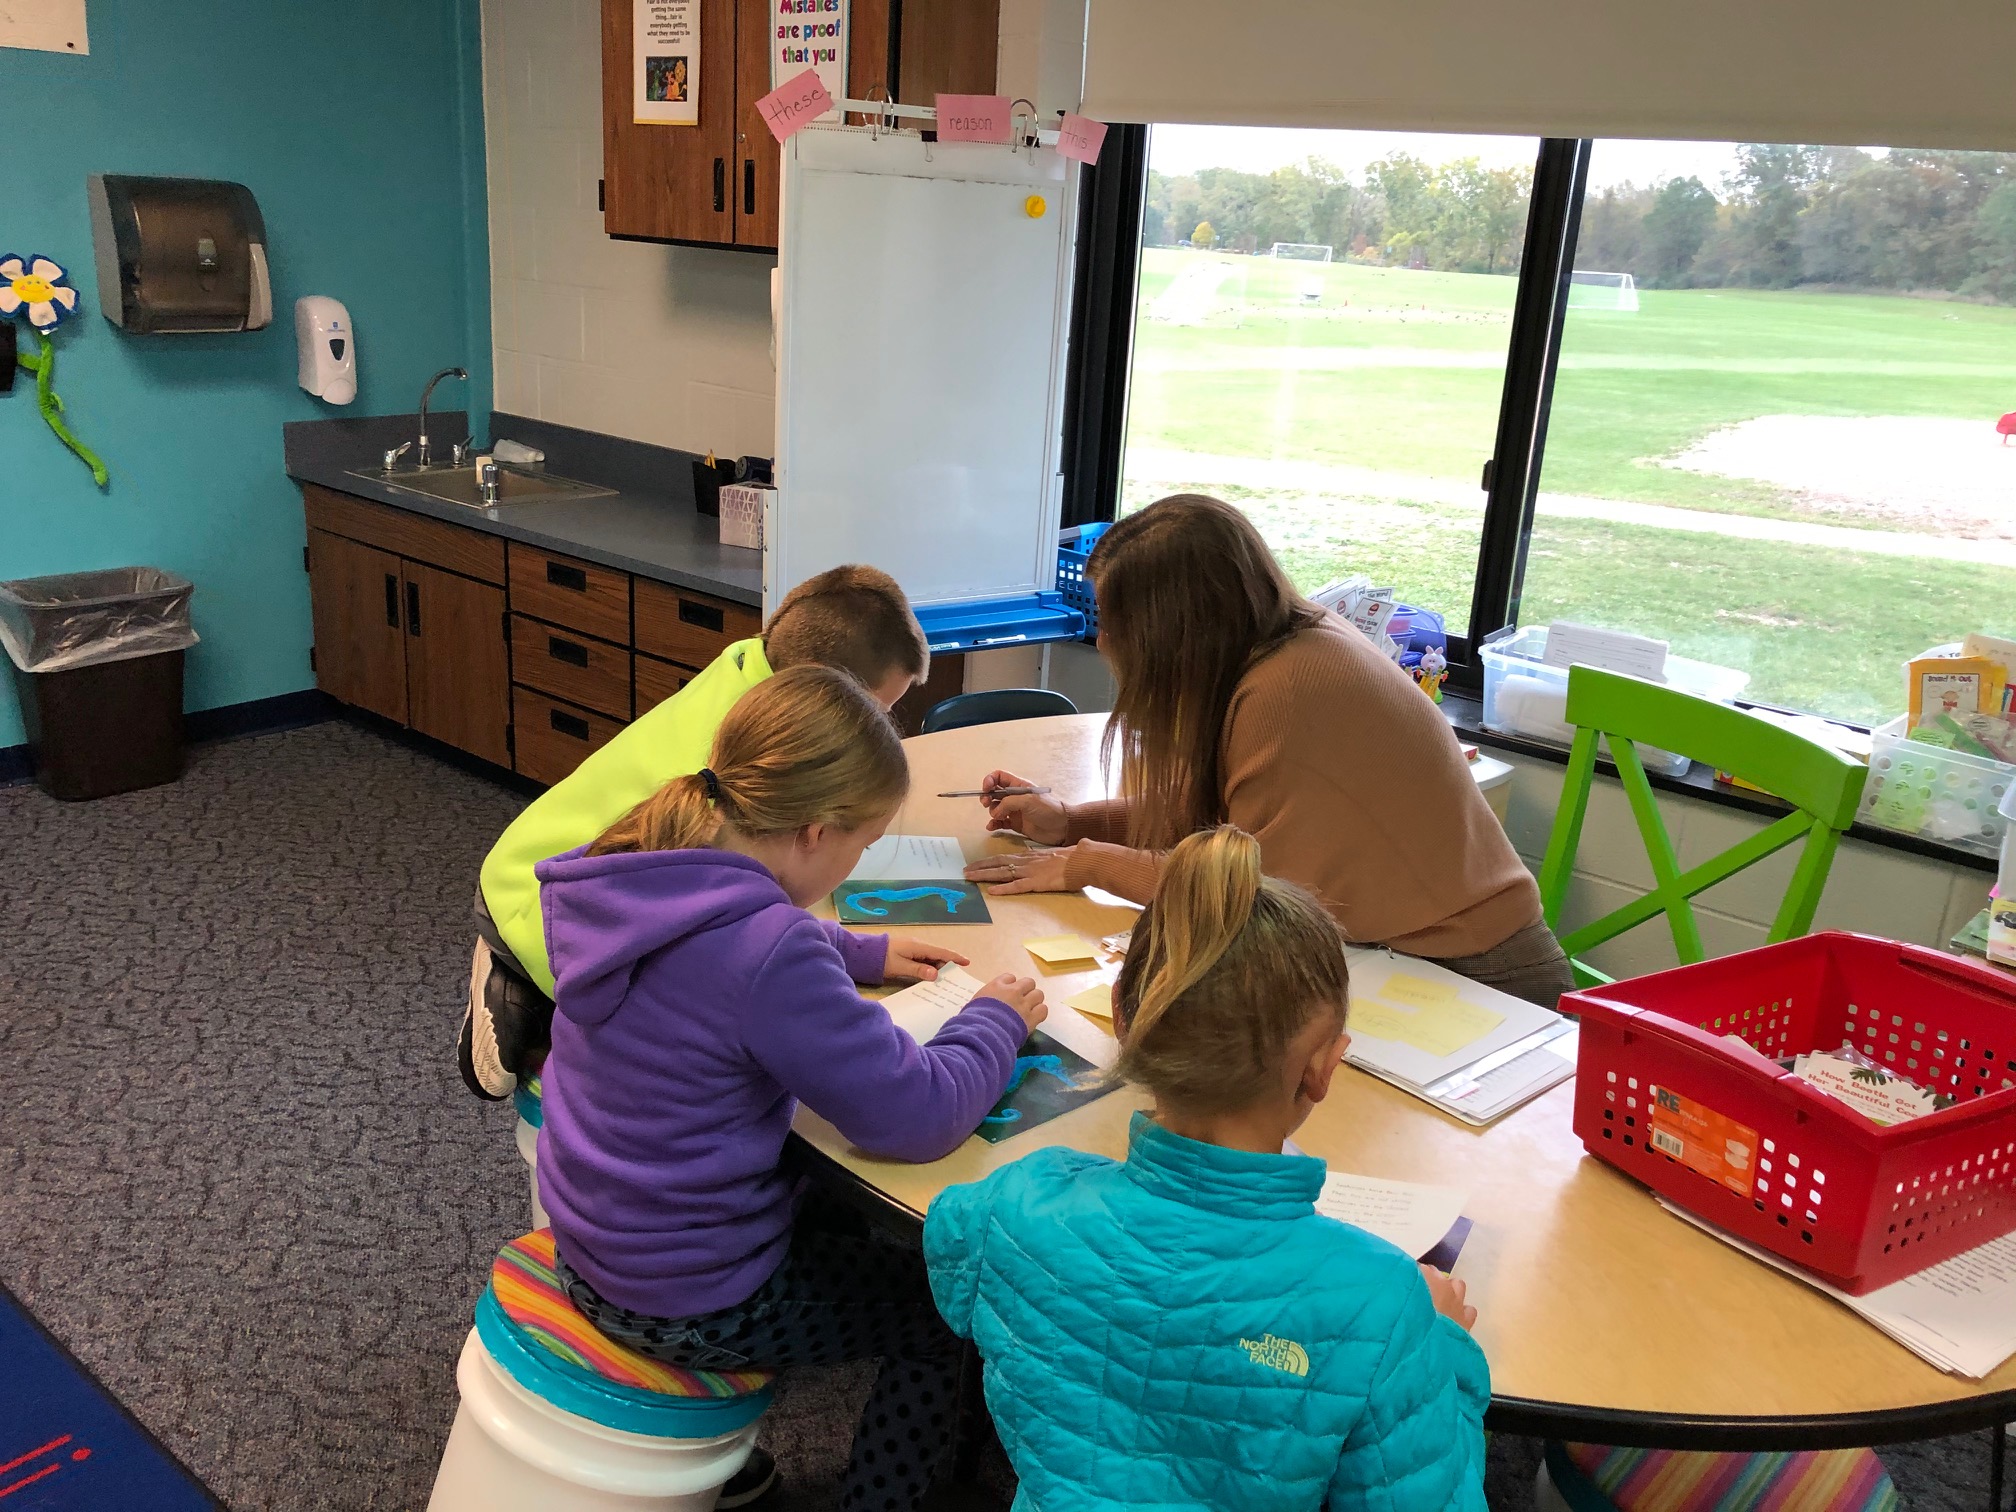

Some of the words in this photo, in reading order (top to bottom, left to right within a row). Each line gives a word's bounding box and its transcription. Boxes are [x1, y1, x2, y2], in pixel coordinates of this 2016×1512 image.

[780, 0, 839, 15] Mistakes
[778, 25, 800, 39] are
[804, 19, 841, 42] proof
[782, 46, 809, 63] that
[812, 48, 836, 66] you
[769, 89, 824, 125] these
[949, 117, 993, 131] reason
[1064, 121, 1089, 150] this
[1657, 1088, 1681, 1114] RE
[1808, 1073, 1830, 1086] Her
[1835, 1083, 1891, 1109] Beautiful
[1896, 1106, 1918, 1118] Coa
[1820, 1069, 1846, 1084] How
[1851, 1081, 1890, 1100] Beetle
[1894, 1097, 1918, 1110] Got
[1239, 1337, 1288, 1361] NORTH
[1263, 1333, 1290, 1350] THE
[1250, 1351, 1283, 1371] FACE
